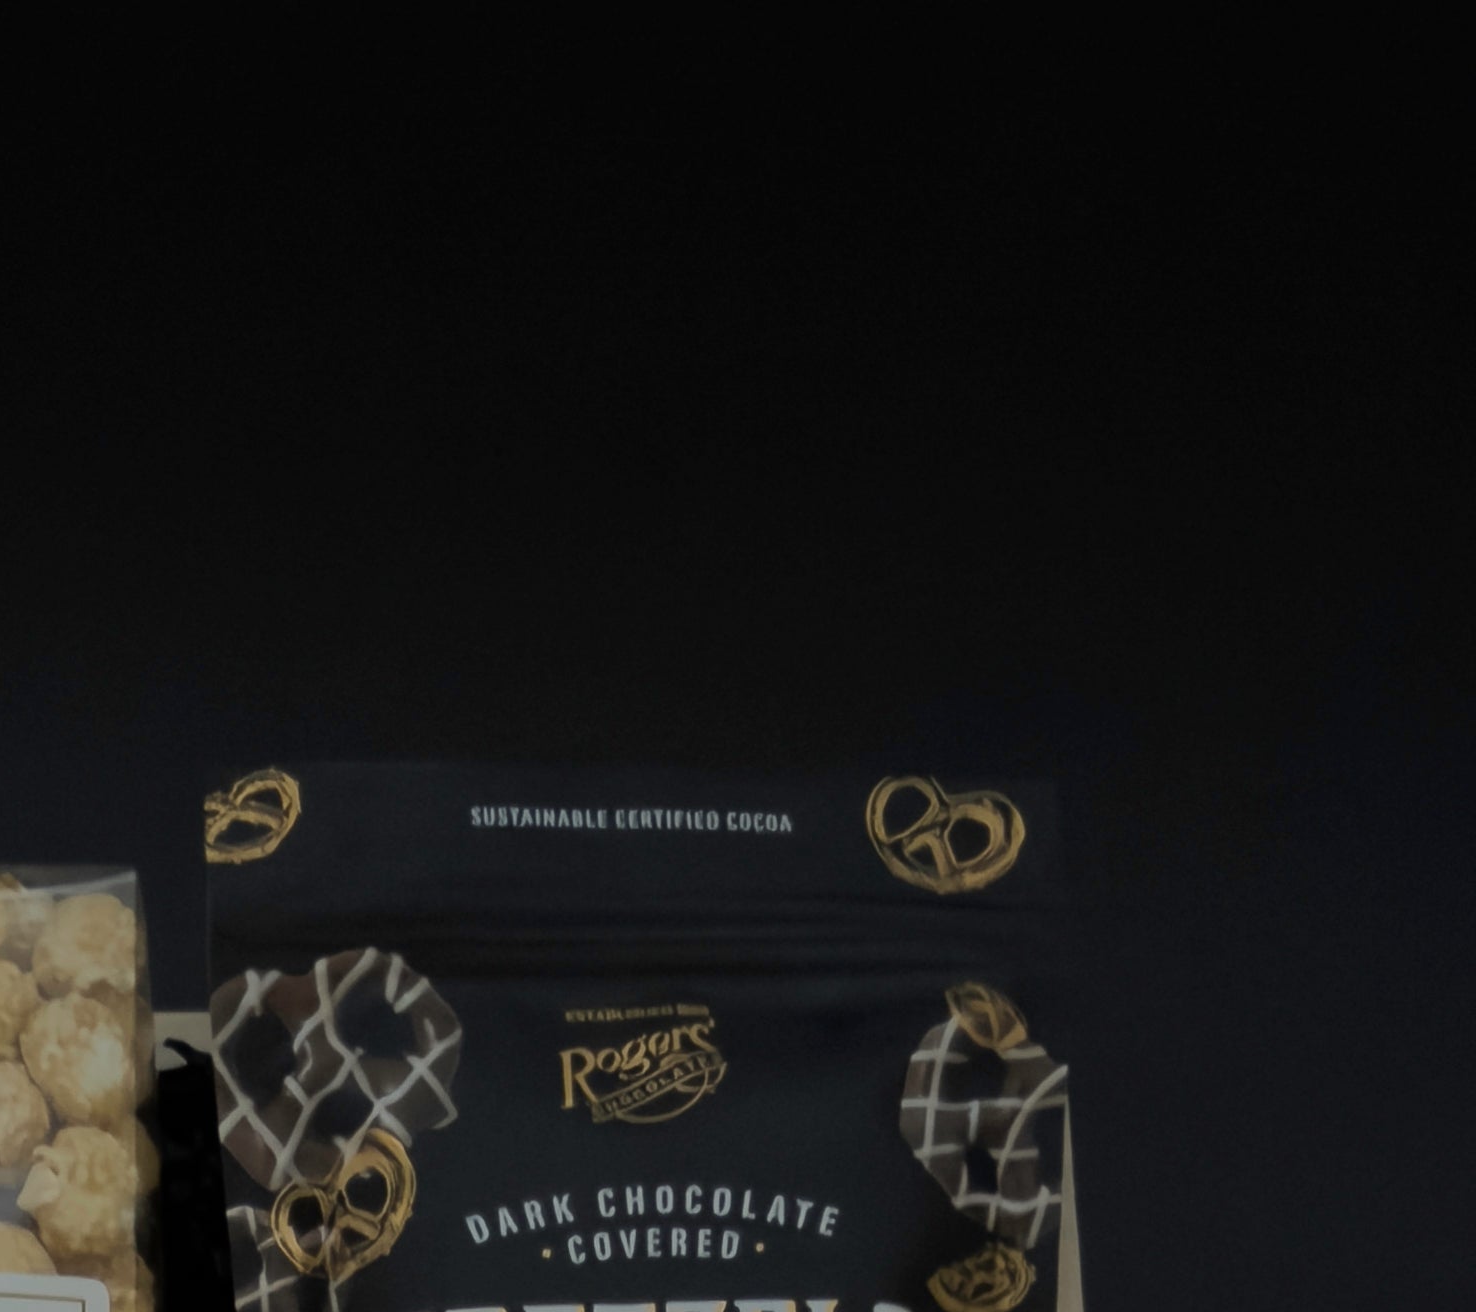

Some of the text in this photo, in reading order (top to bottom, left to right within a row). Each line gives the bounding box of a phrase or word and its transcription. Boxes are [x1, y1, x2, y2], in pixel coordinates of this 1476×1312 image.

[470, 806, 792, 833] SUSTAINABLE CERTIFIED COCOA
[465, 1185, 840, 1244] DARK CHOCOLATE
[567, 1227, 740, 1265] COVERED
